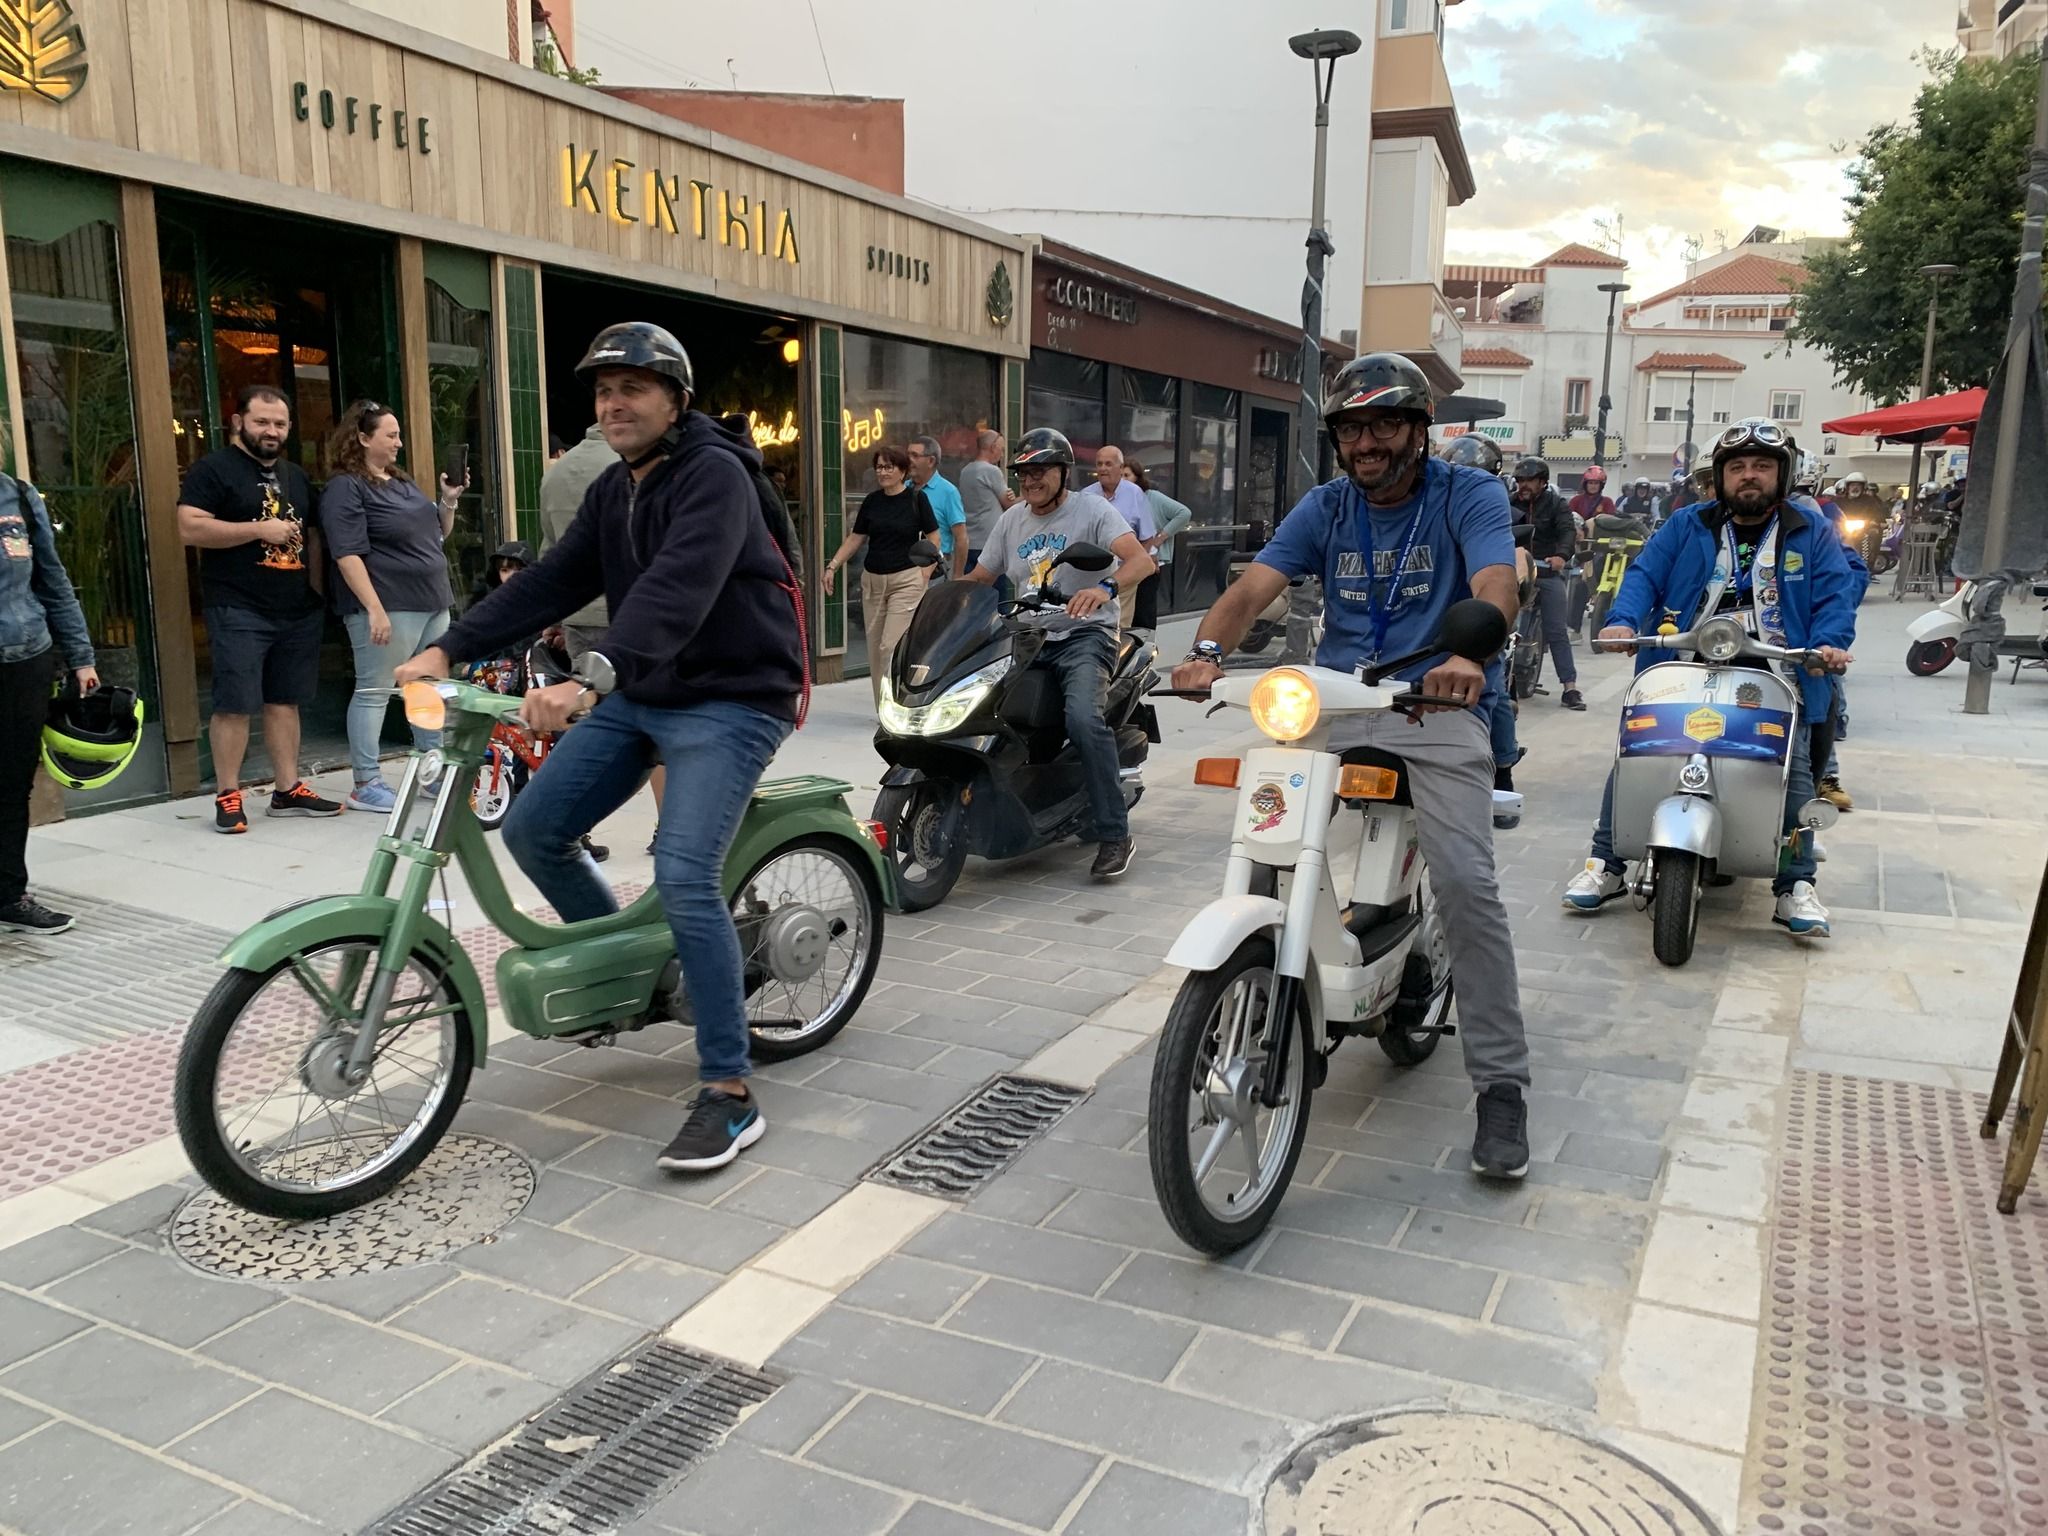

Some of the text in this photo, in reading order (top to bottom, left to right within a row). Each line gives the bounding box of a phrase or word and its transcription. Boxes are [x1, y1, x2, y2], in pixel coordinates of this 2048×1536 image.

[294, 82, 431, 154] COFFEE
[867, 245, 930, 285] SPIRITS
[1443, 426, 1514, 438] MERCENTRO
[1017, 533, 1067, 559] SOY LA
[1335, 545, 1434, 578] MAHATAN
[1339, 583, 1430, 600] UNITED STATES
